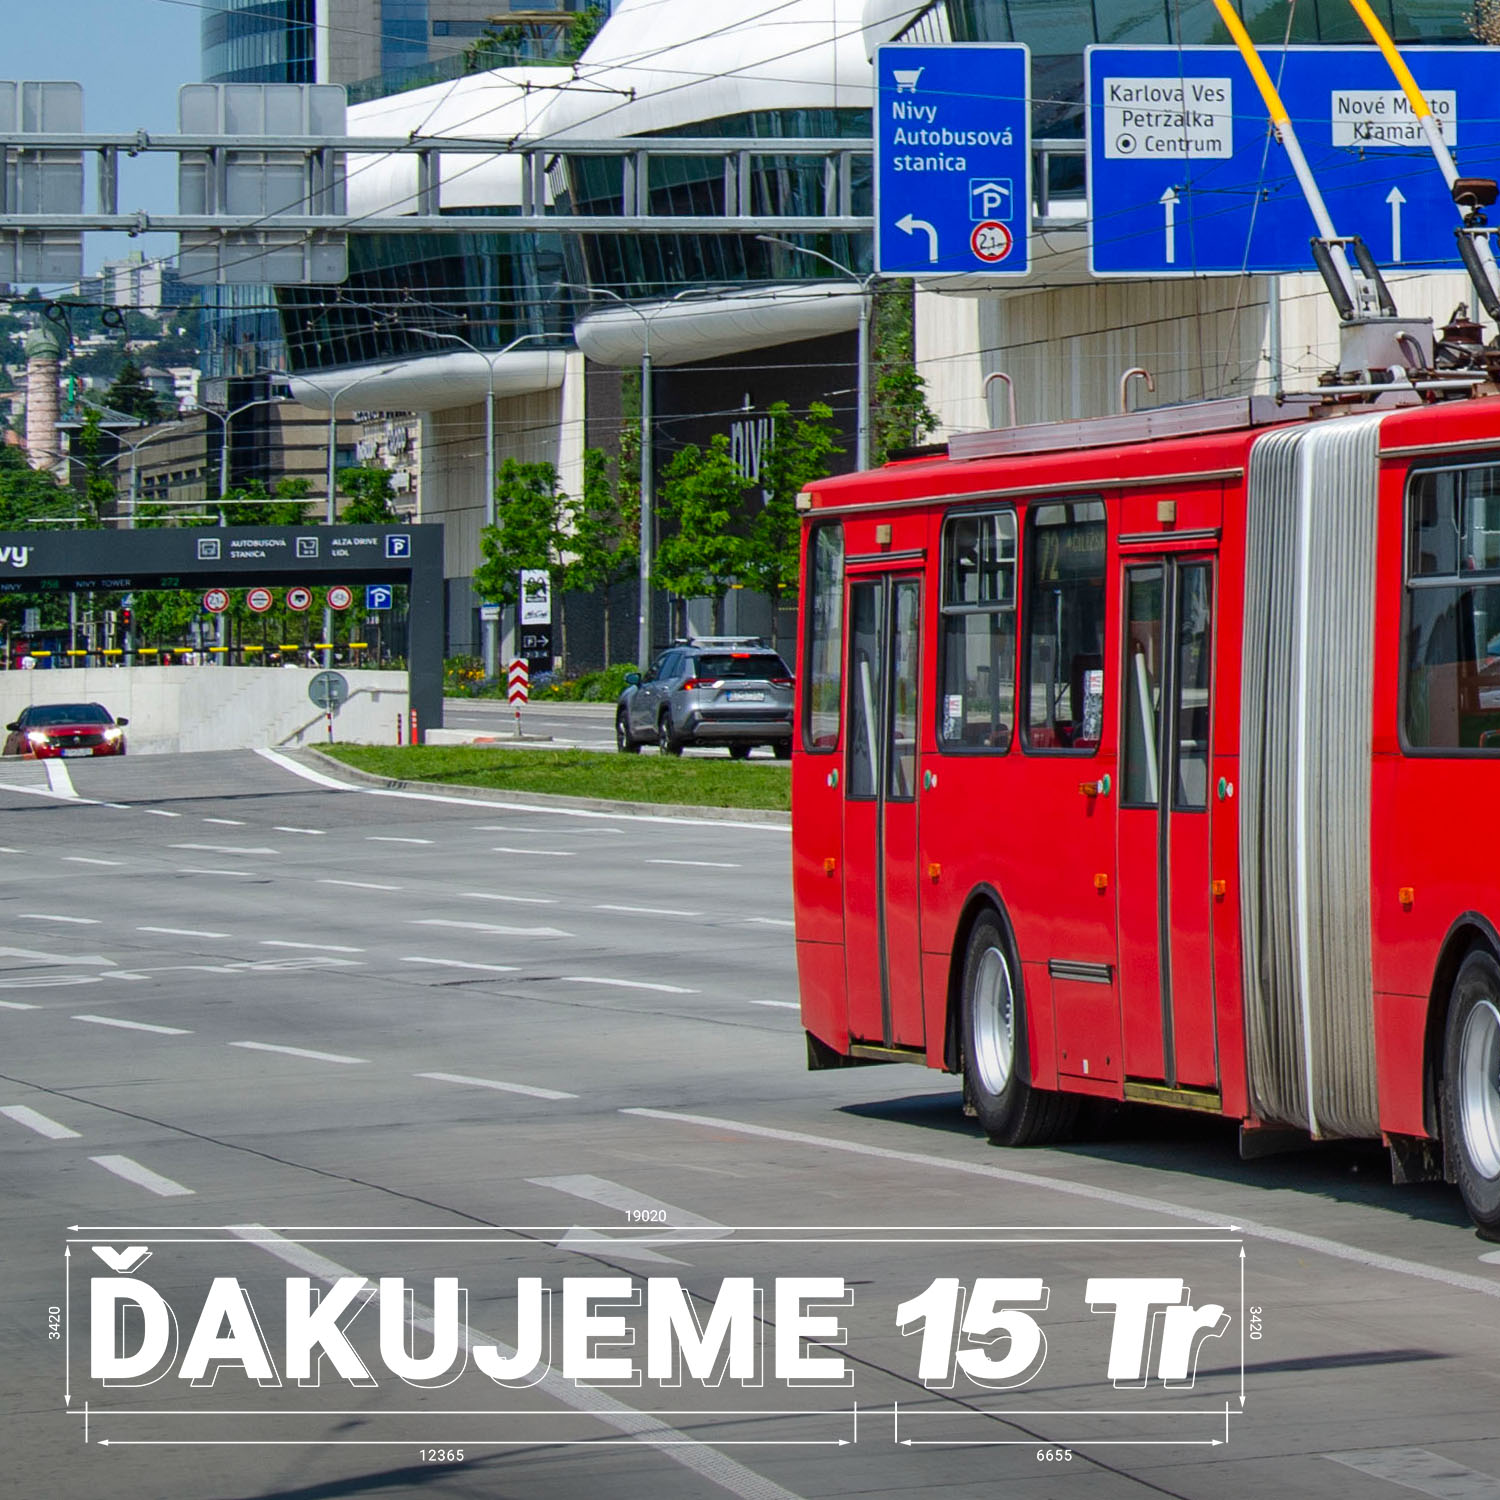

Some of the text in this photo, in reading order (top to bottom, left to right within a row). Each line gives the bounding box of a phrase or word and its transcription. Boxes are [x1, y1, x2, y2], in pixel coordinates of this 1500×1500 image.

[1109, 83, 1226, 103] Karlova Ves
[891, 101, 938, 125] Nivy
[1338, 96, 1450, 115] Nové Mto
[1122, 108, 1215, 128] Petržalka
[893, 126, 1014, 147] Autobusová
[1353, 121, 1432, 140] Kramár
[1144, 135, 1223, 153] Centrum
[893, 154, 967, 172] stanica
[983, 192, 1002, 217] P
